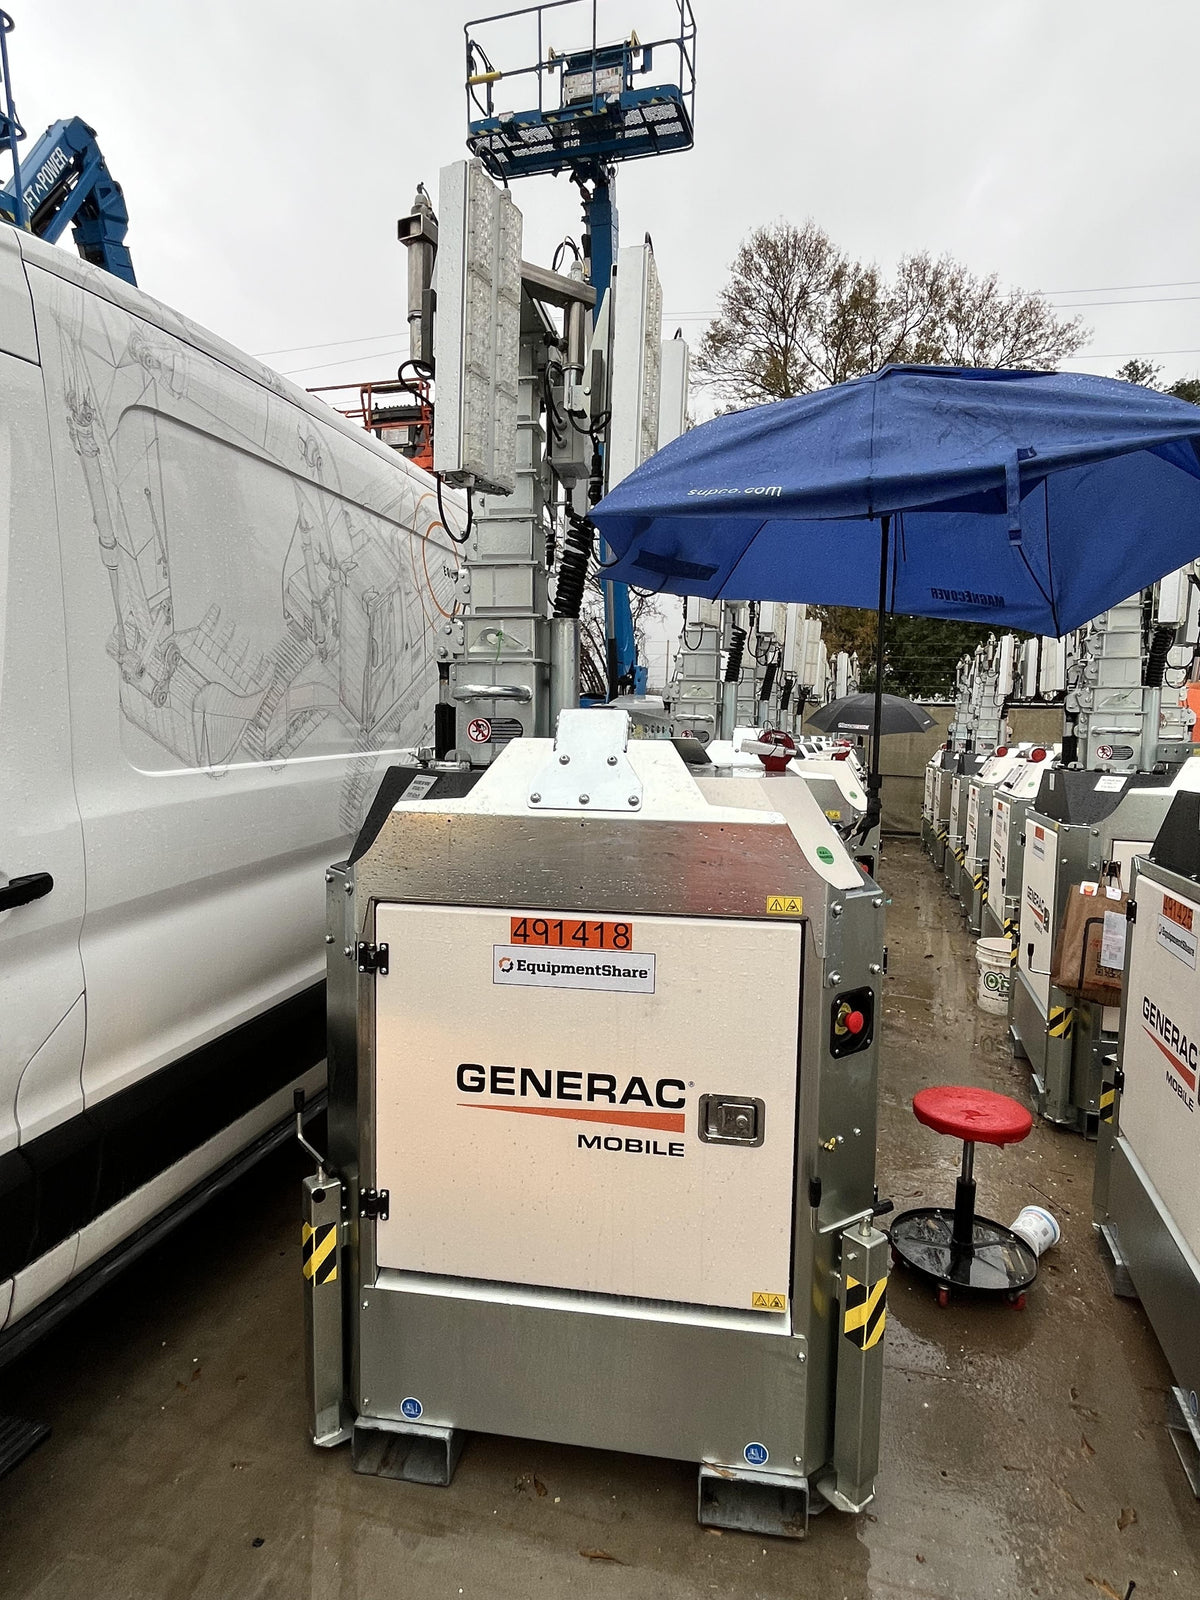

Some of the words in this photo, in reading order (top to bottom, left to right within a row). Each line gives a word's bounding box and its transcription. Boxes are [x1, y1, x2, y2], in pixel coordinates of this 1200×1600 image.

[22, 184, 41, 216] IFT
[36, 146, 69, 191] POWER
[687, 486, 782, 497] supco.com
[513, 918, 630, 949] 491418
[516, 959, 648, 979] EquipmentShare
[1142, 996, 1198, 1071] GENERAC
[1165, 1070, 1194, 1113] MOBILE
[577, 1134, 685, 1157] MOBILE
